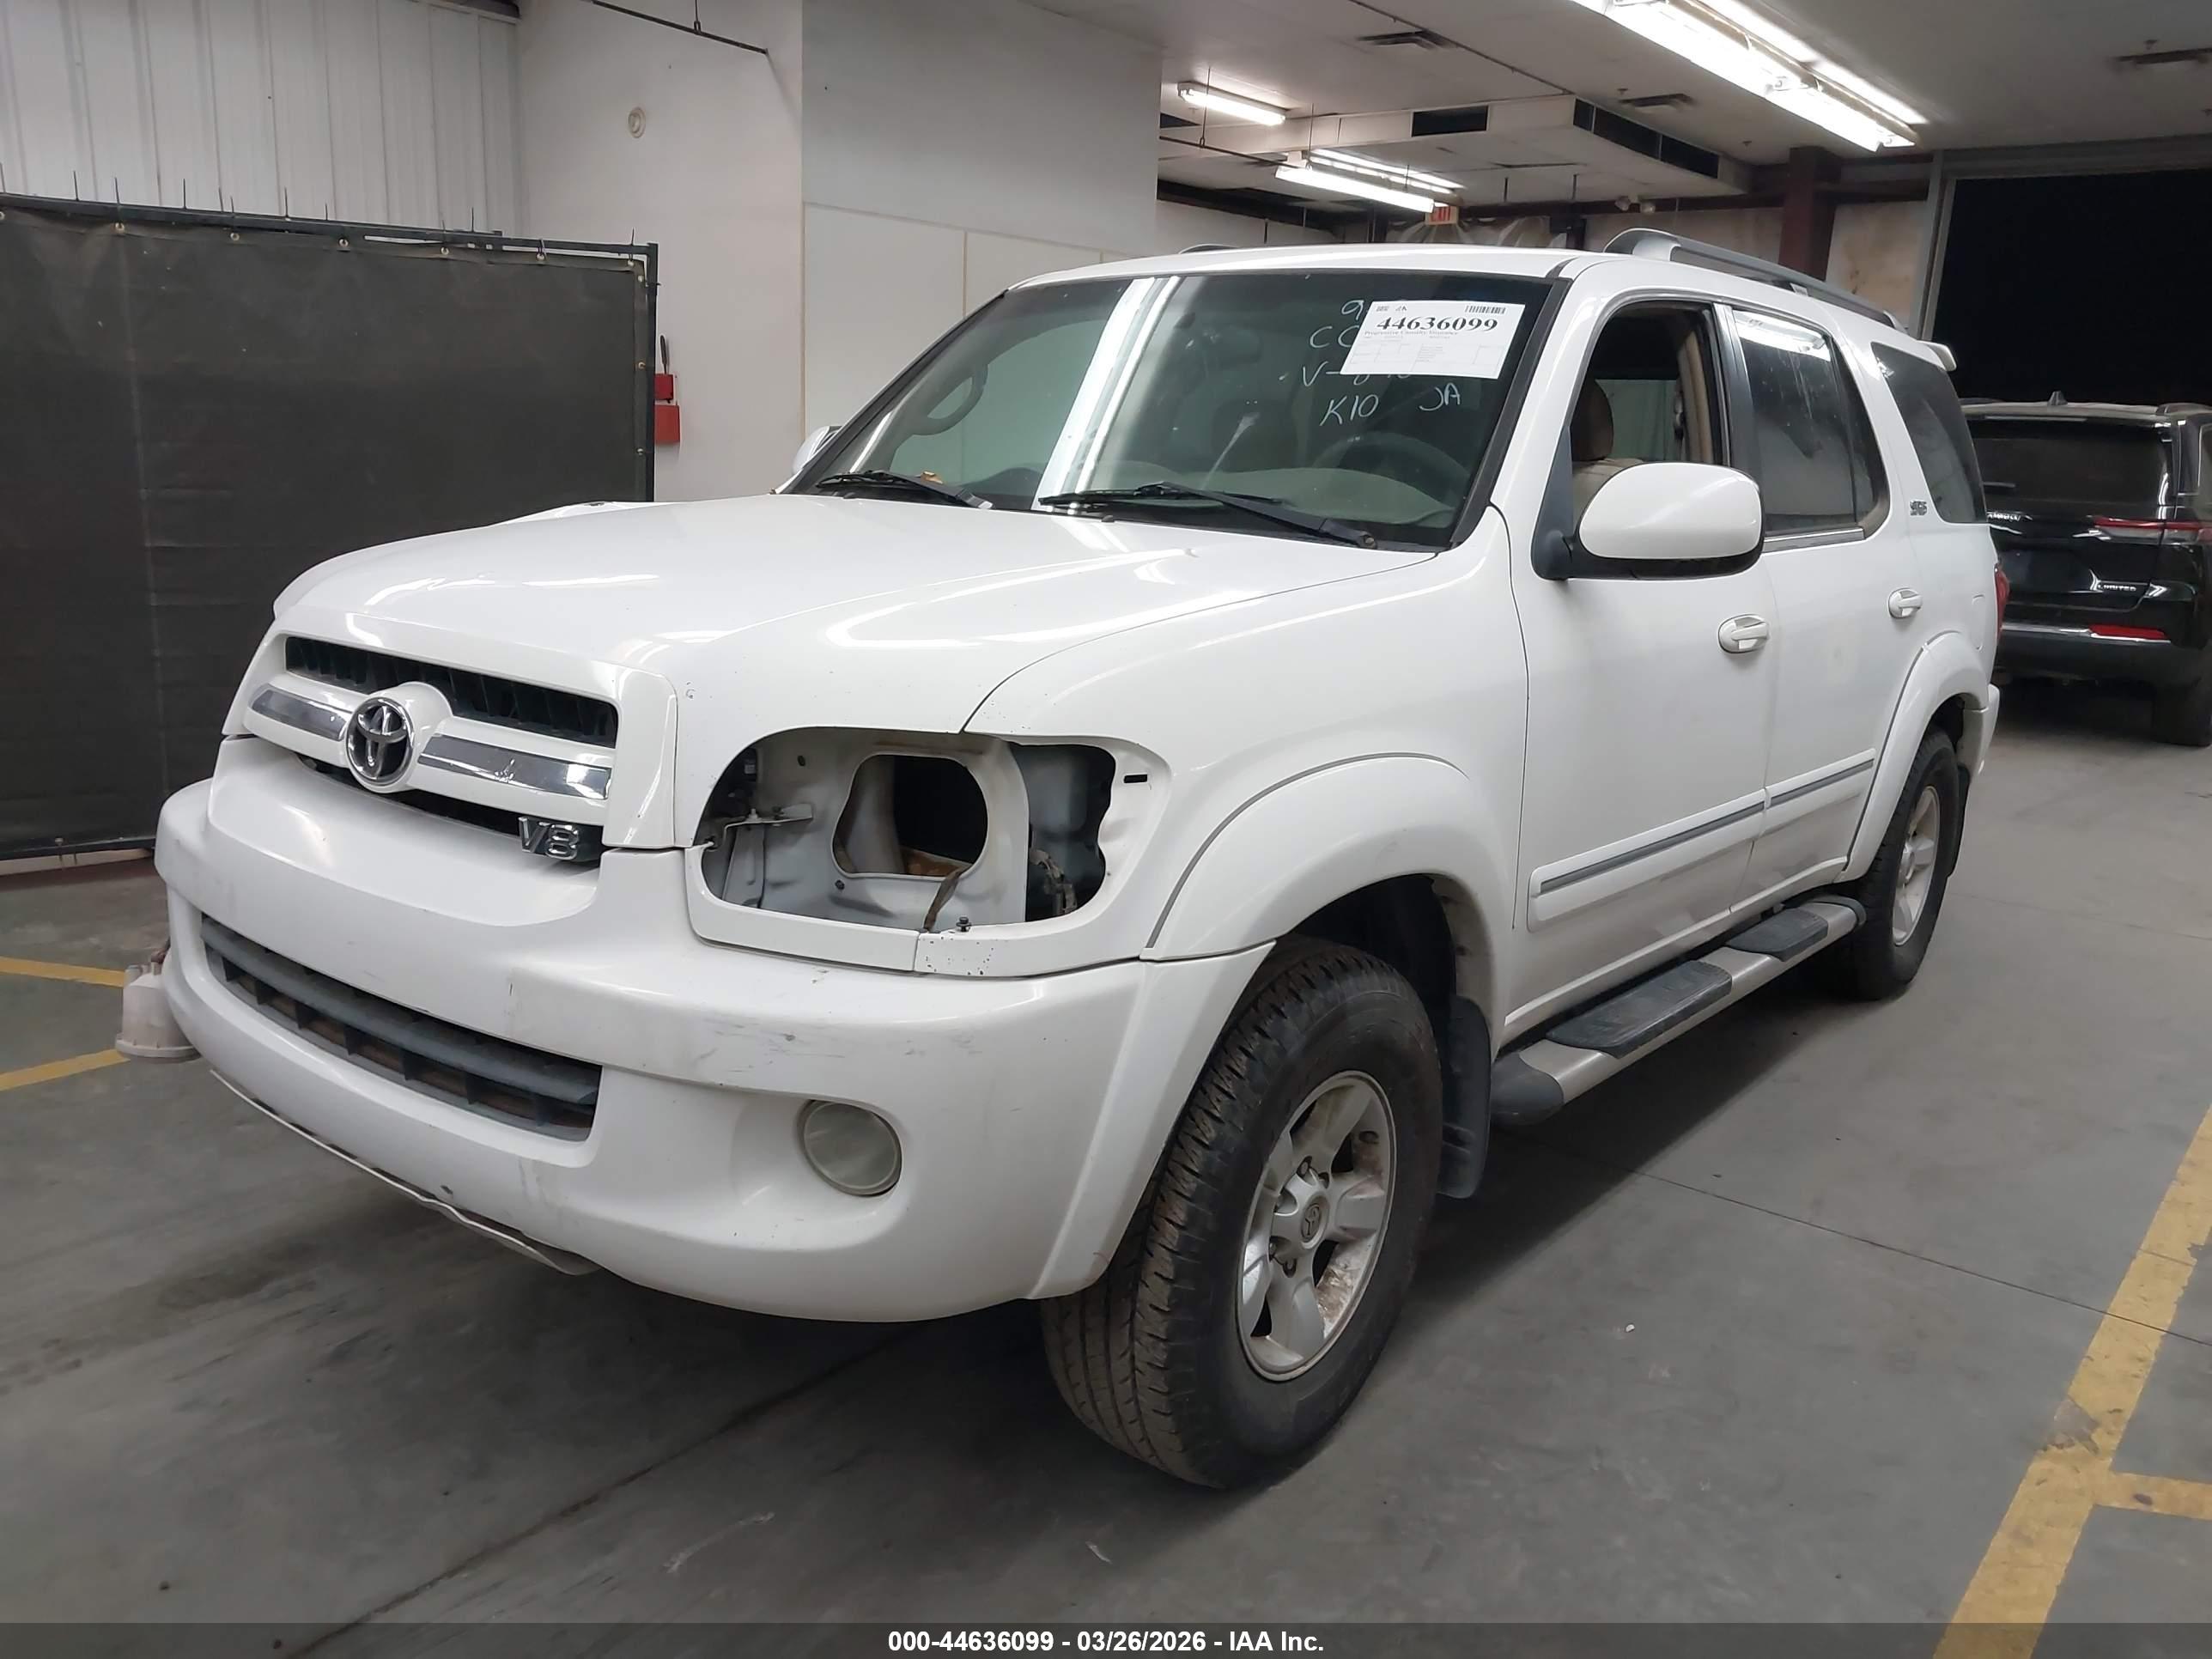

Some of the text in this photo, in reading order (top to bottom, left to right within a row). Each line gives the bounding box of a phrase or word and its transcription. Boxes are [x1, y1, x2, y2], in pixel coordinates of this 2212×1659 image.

[1376, 317, 1498, 331] 44636099
[1319, 394, 1379, 426] K10
[519, 817, 580, 860] V8
